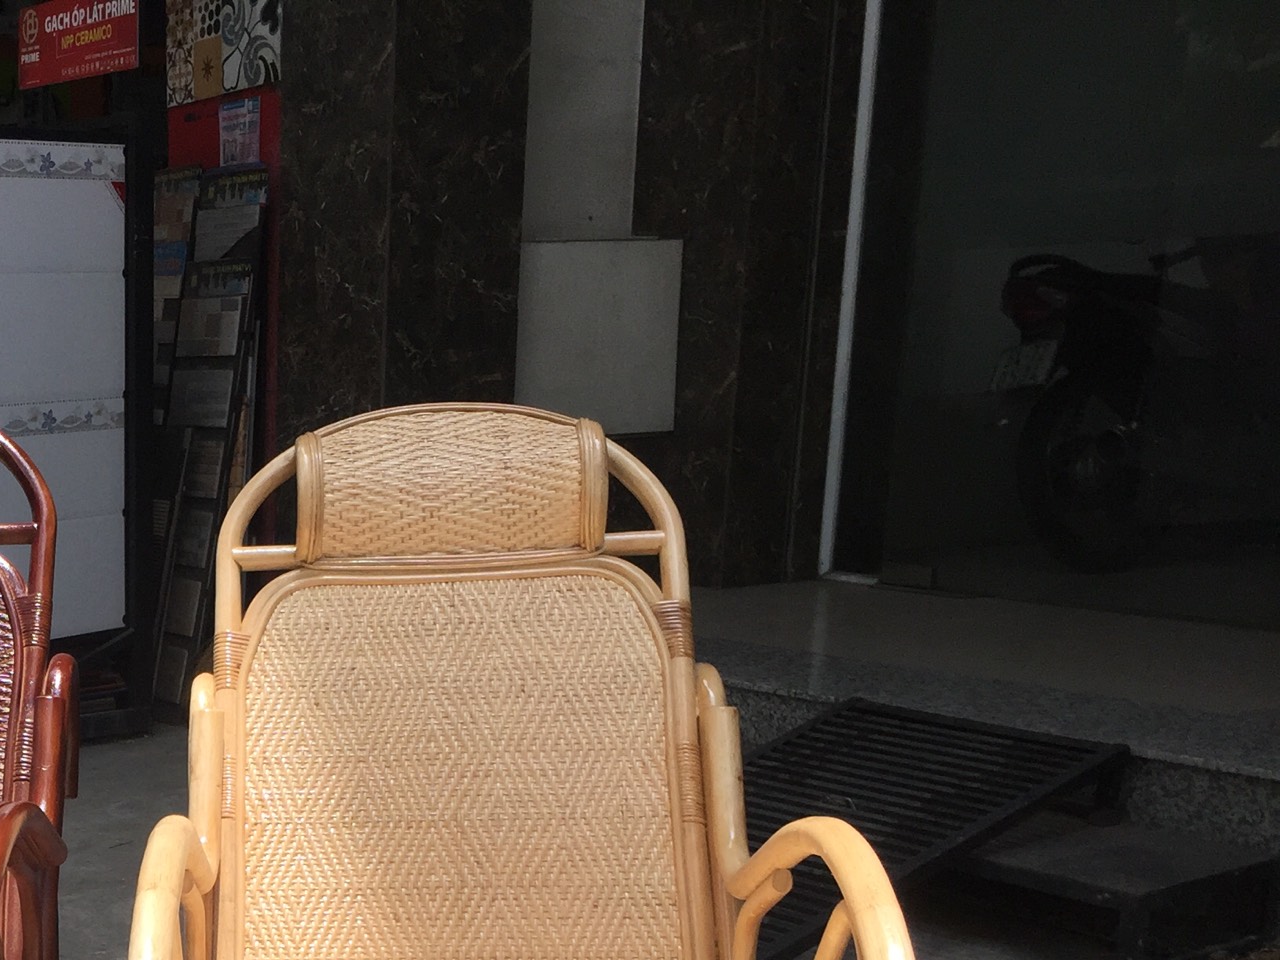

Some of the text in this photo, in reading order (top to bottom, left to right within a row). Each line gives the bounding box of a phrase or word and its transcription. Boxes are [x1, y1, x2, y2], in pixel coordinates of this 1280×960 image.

[45, 11, 71, 37] GẠCH
[86, 1, 104, 24] LÁT
[105, 0, 136, 20] PRIME
[75, 23, 112, 46] CERAMICO
[20, 51, 40, 65] PRIME
